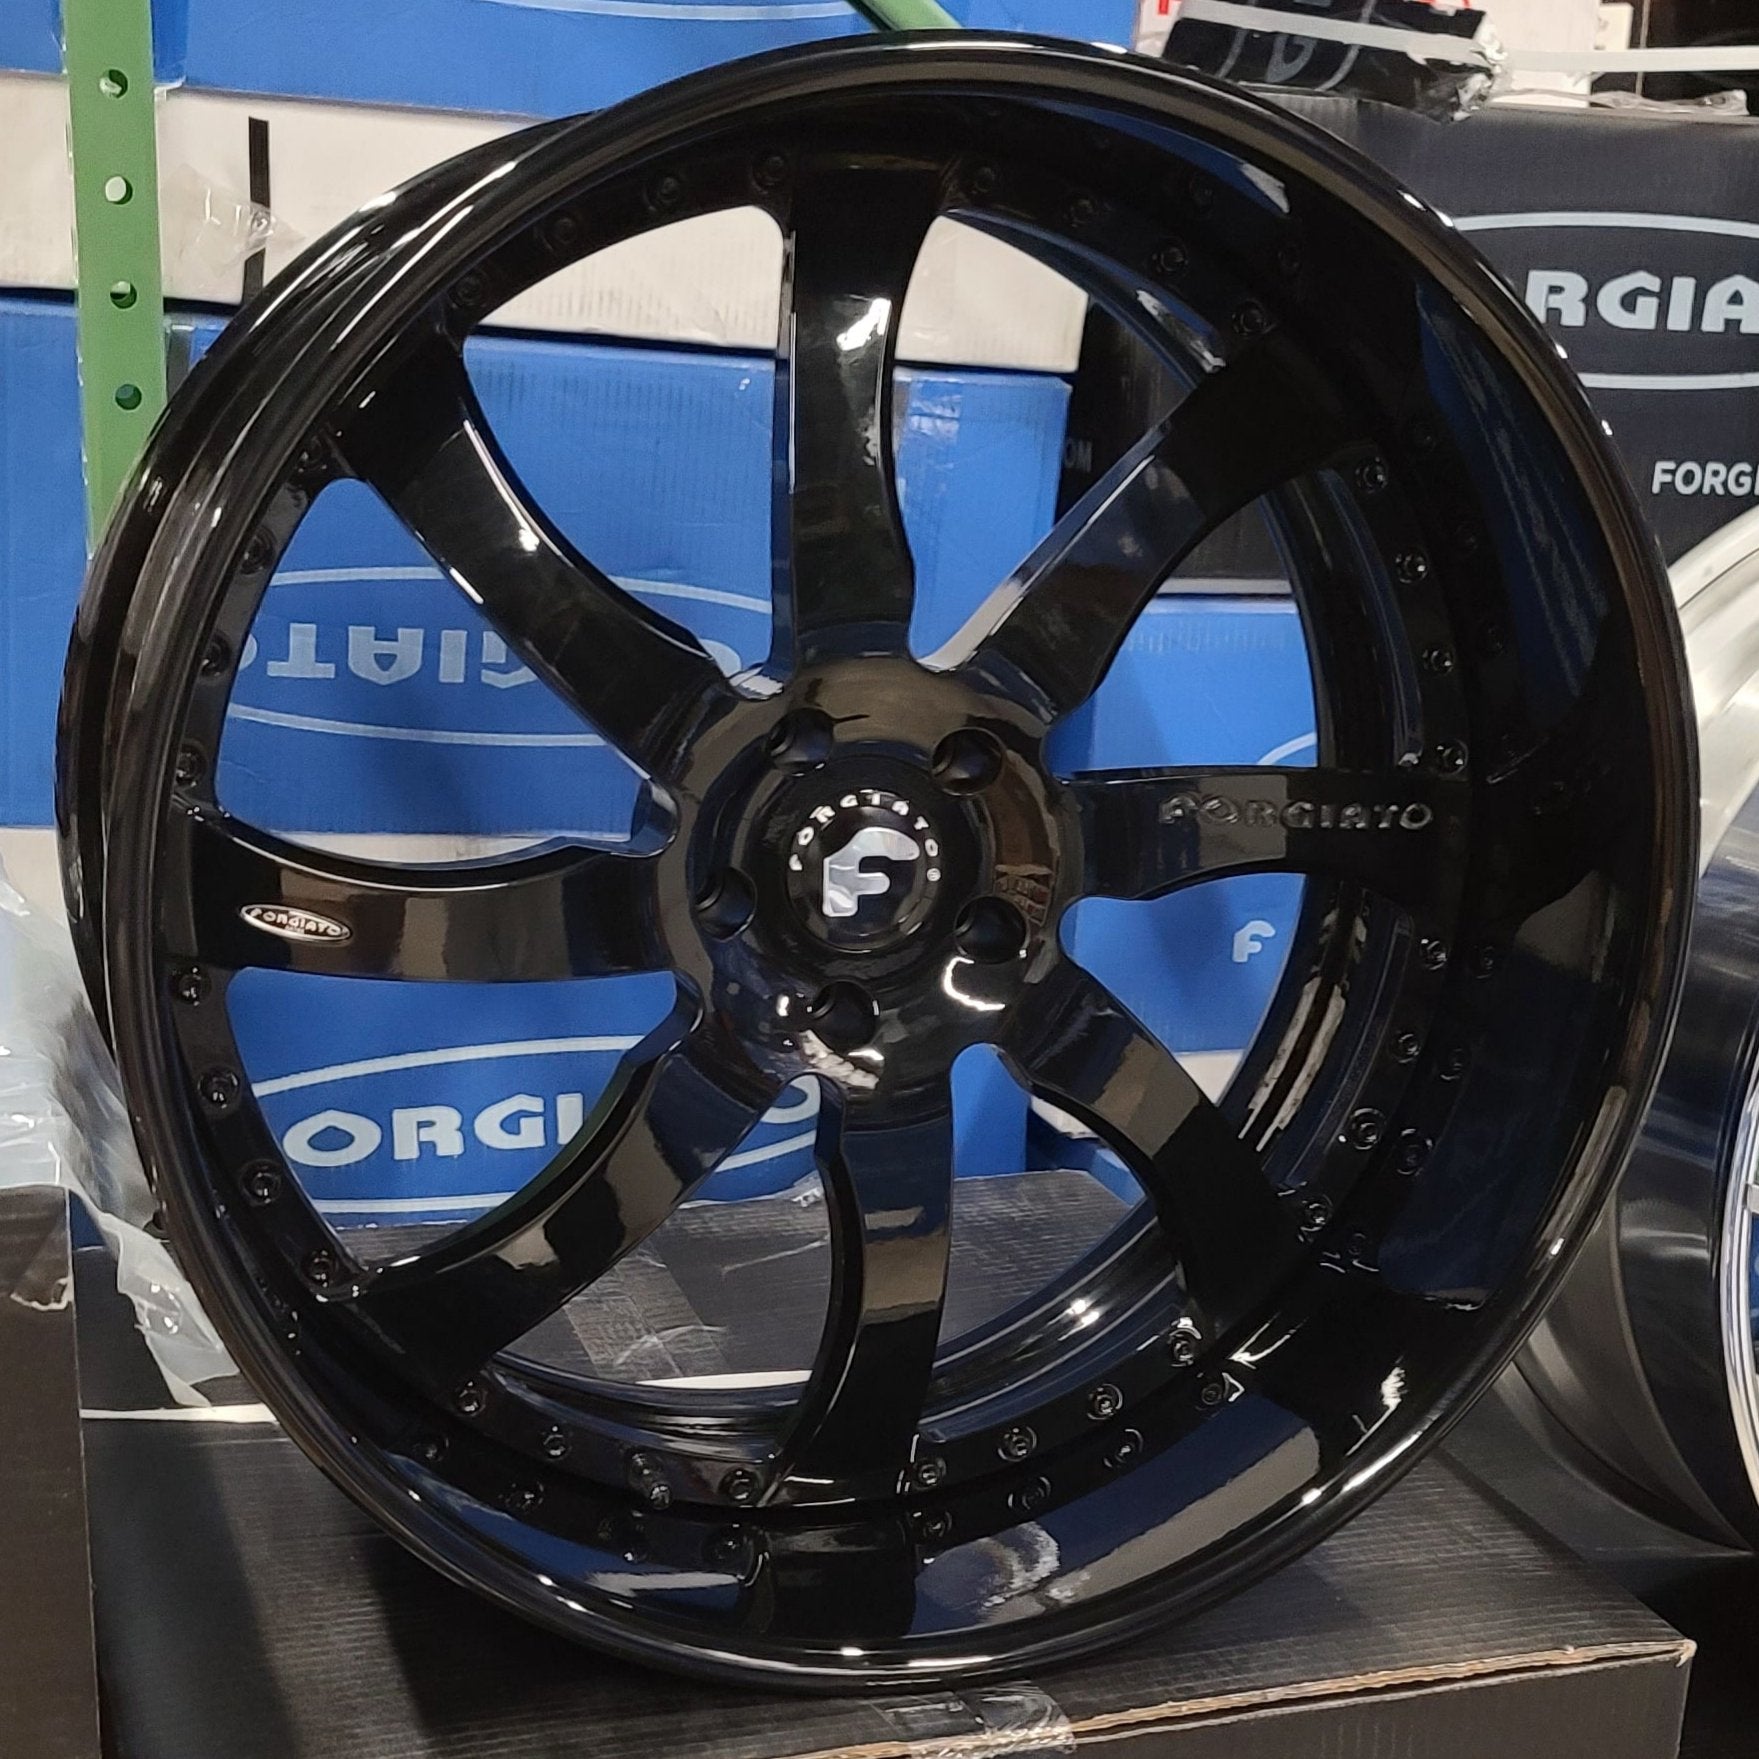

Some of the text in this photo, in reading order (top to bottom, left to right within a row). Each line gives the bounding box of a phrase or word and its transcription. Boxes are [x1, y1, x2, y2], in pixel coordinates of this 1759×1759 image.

[231, 622, 538, 686] GIAT
[788, 792, 939, 871] FORGIATO
[1158, 792, 1433, 829] FORGIATO
[822, 826, 920, 917] F
[1232, 920, 1276, 963] F
